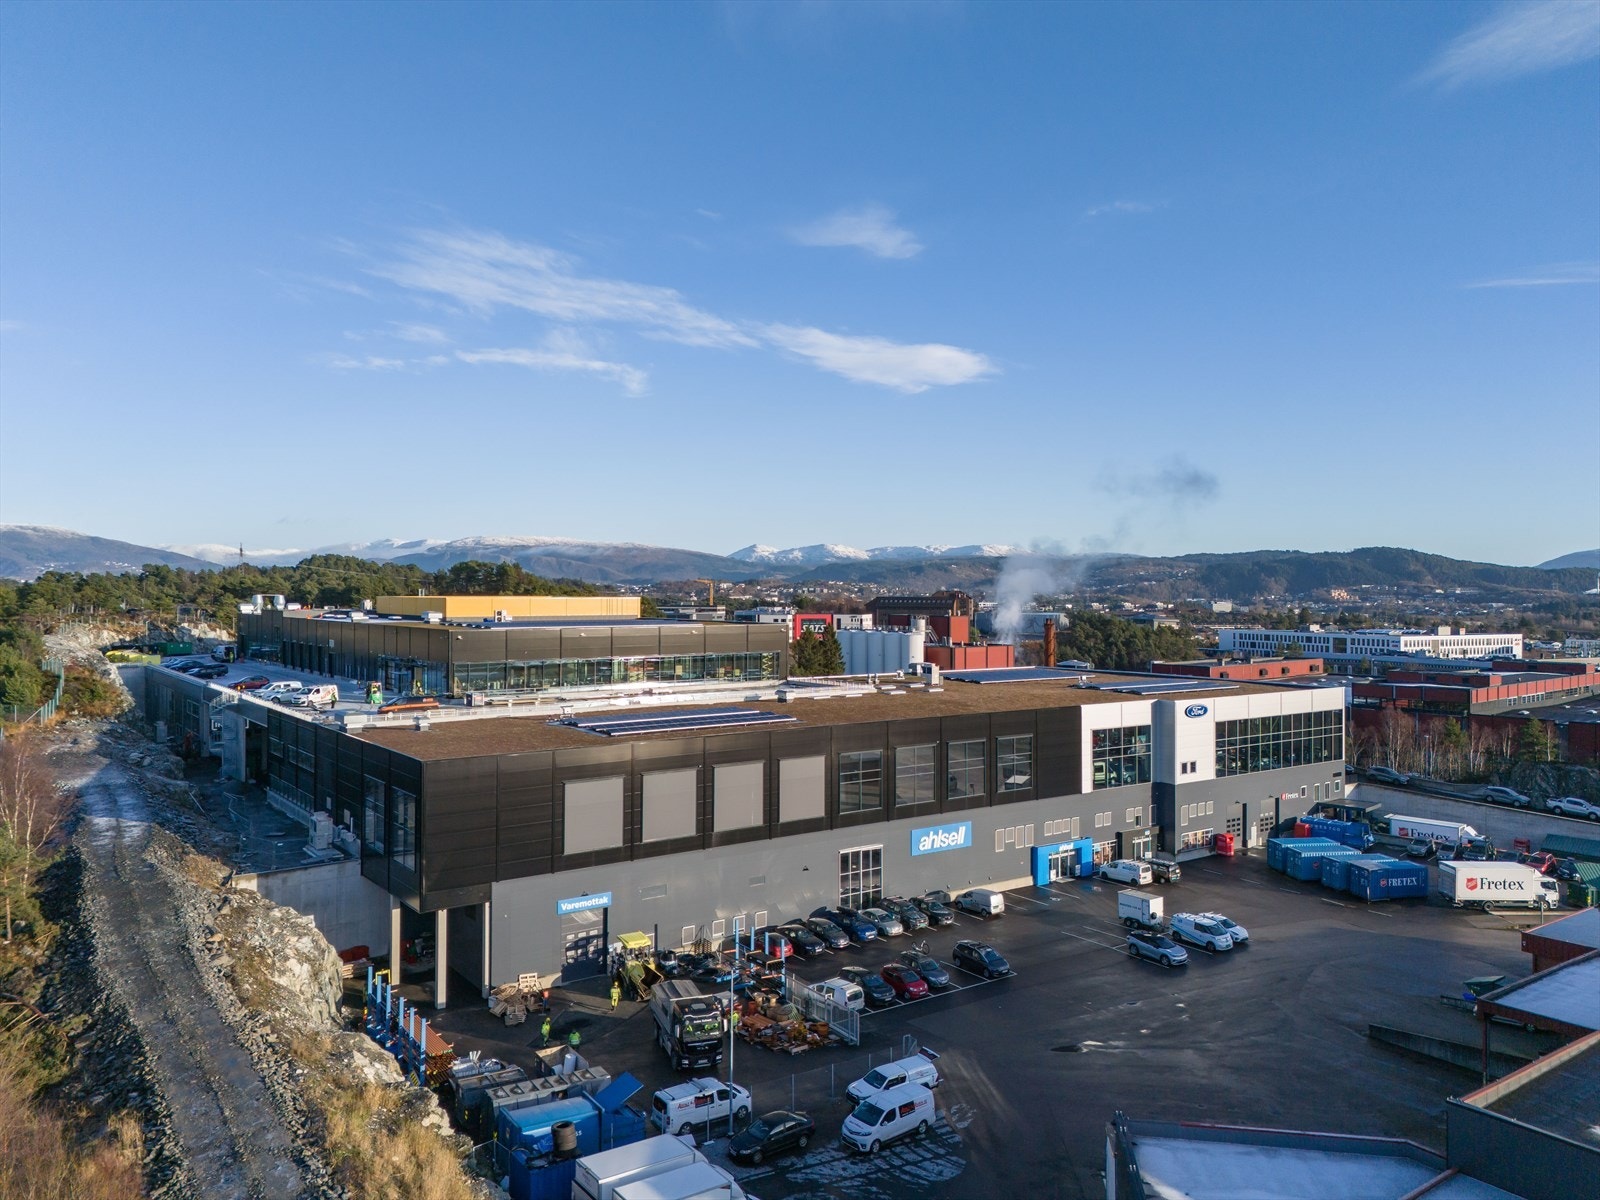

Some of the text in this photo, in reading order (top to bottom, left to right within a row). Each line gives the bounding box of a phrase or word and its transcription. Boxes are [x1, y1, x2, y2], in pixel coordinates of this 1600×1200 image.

[801, 625, 827, 633] SATS
[918, 826, 966, 851] ahlsell
[1410, 829, 1450, 840] Fretex
[1388, 878, 1418, 887] FRETEX
[1480, 877, 1525, 891] Fretex
[560, 896, 609, 911] Varemottak
